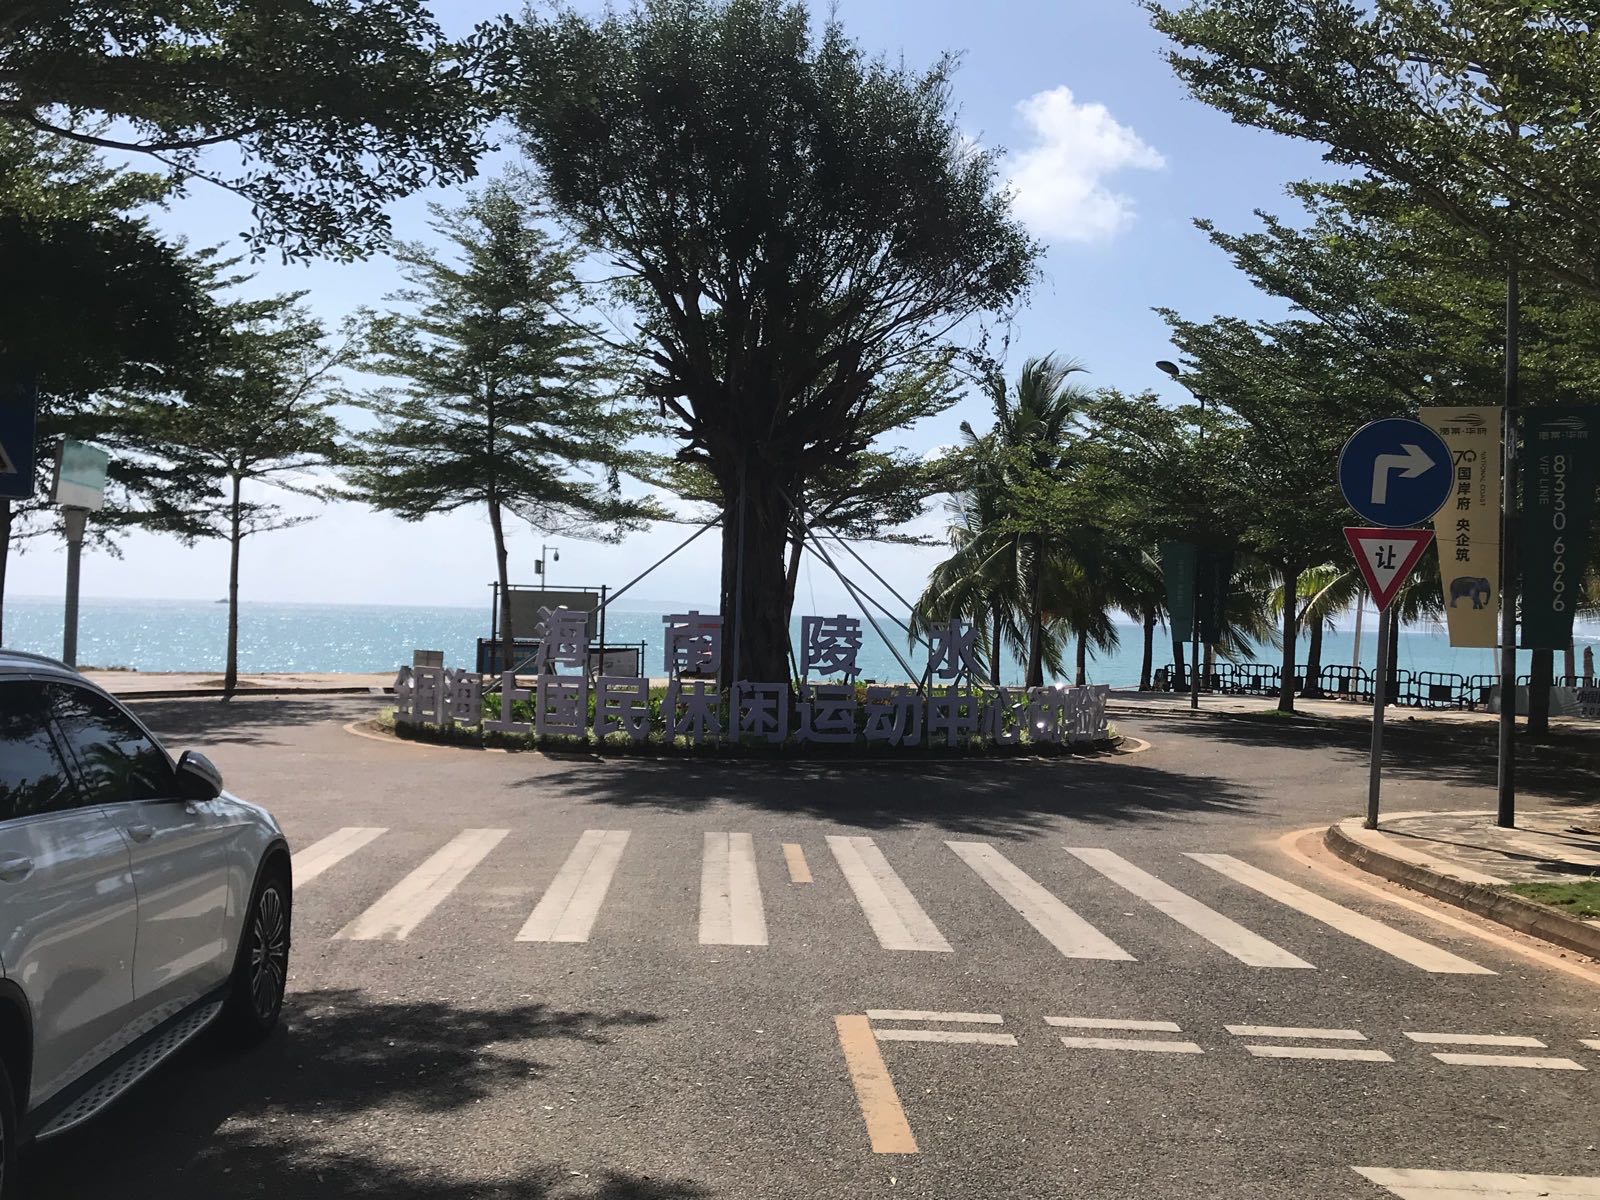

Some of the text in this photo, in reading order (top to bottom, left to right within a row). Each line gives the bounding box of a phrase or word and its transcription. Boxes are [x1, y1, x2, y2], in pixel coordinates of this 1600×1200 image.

[1456, 467, 1471, 562] 国岸府 央企筑
[1539, 455, 1549, 505] VIP LINE
[1375, 545, 1396, 569] 让
[1552, 455, 1566, 613] 8330 6666
[535, 605, 980, 680] 海南陵水
